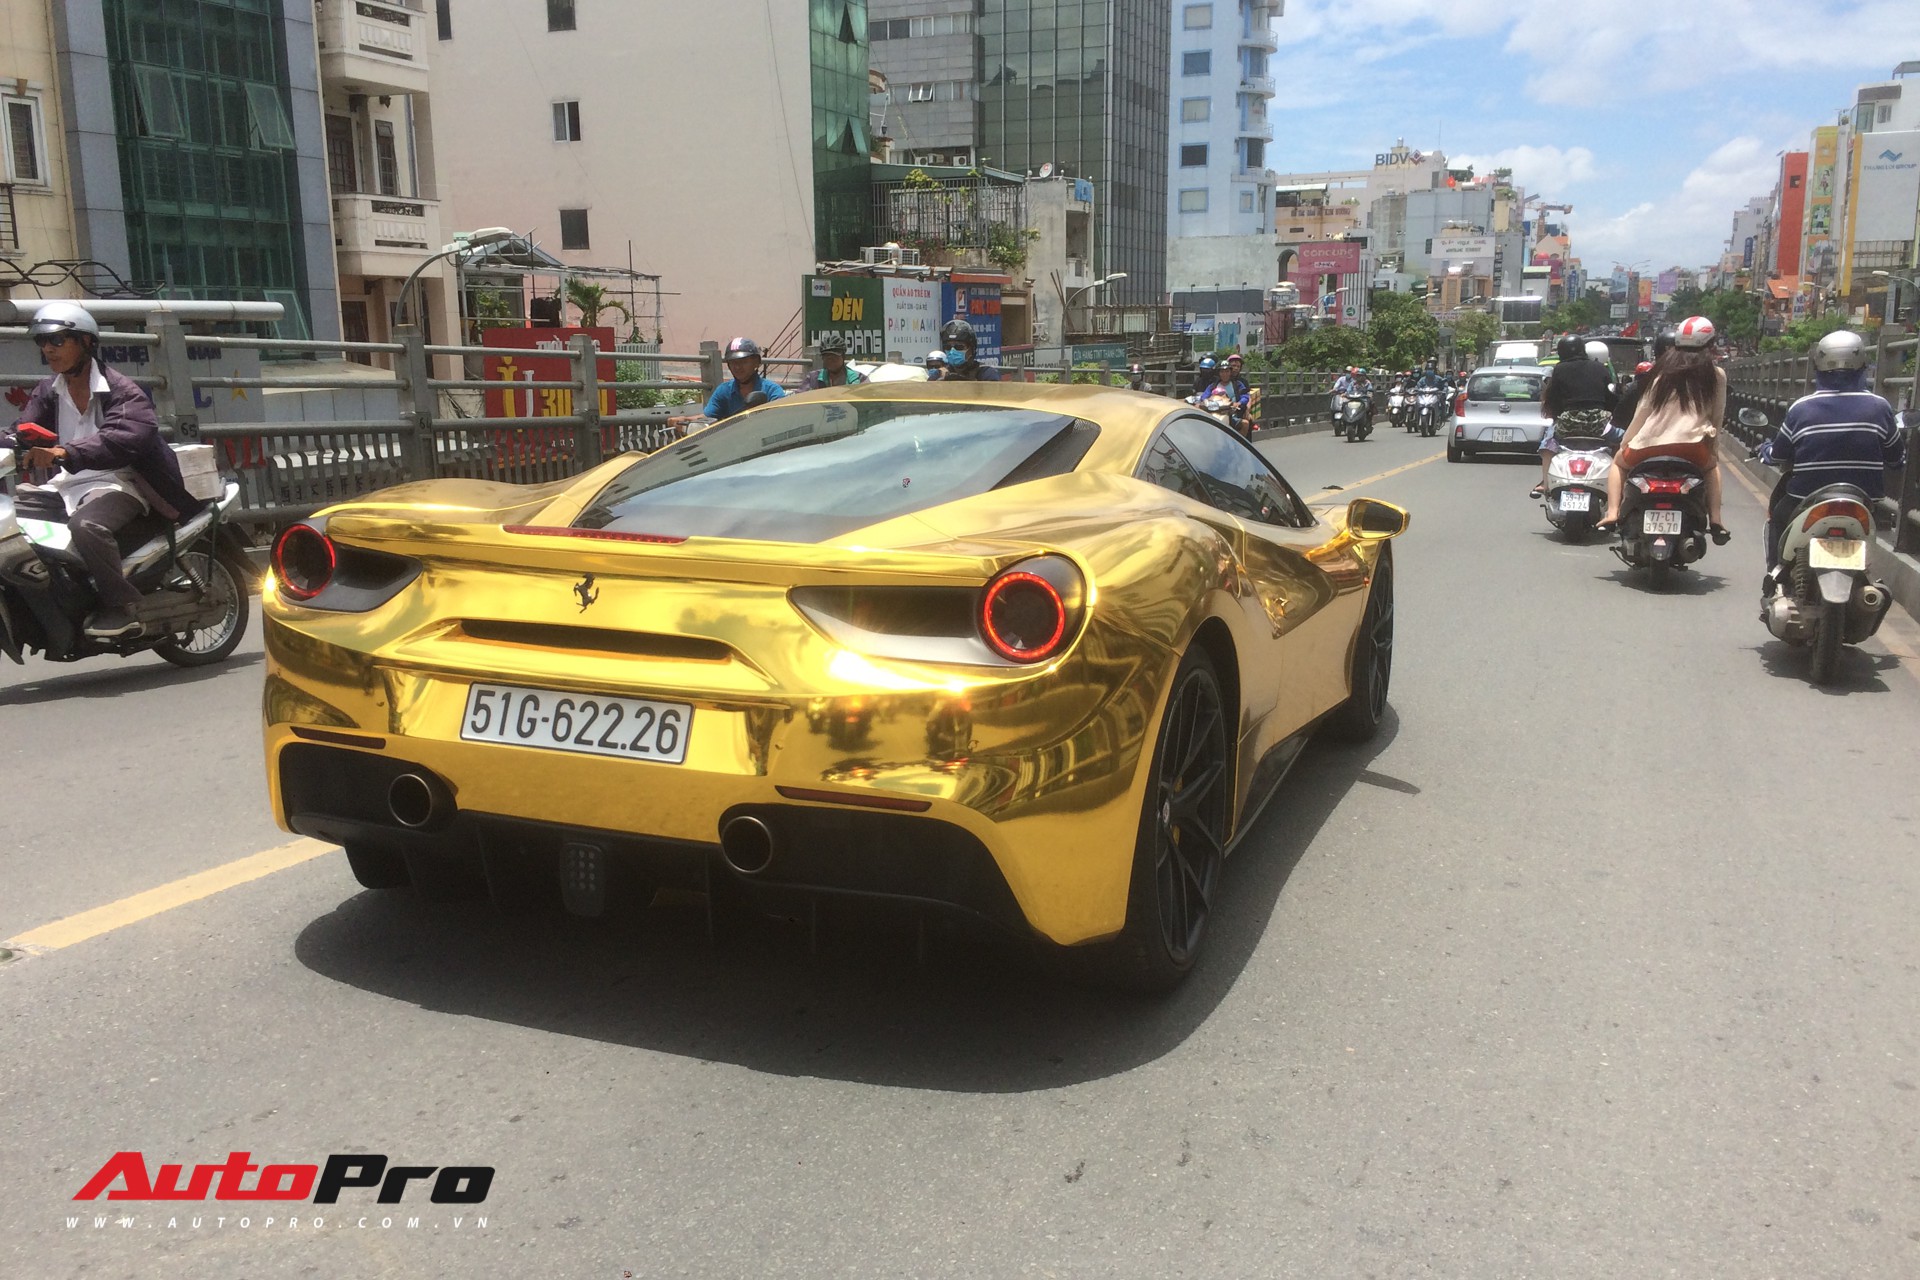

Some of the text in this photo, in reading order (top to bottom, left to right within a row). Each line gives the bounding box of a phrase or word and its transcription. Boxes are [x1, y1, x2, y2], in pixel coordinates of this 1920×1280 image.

[1375, 152, 1410, 166] BIDV
[832, 291, 863, 321] ĐÈN
[912, 319, 936, 332] MAMI
[180, 422, 197, 438] 65
[1650, 512, 1675, 522] 77-C1
[1645, 523, 1678, 533] 375.70
[471, 690, 681, 755] 51G-622.26
